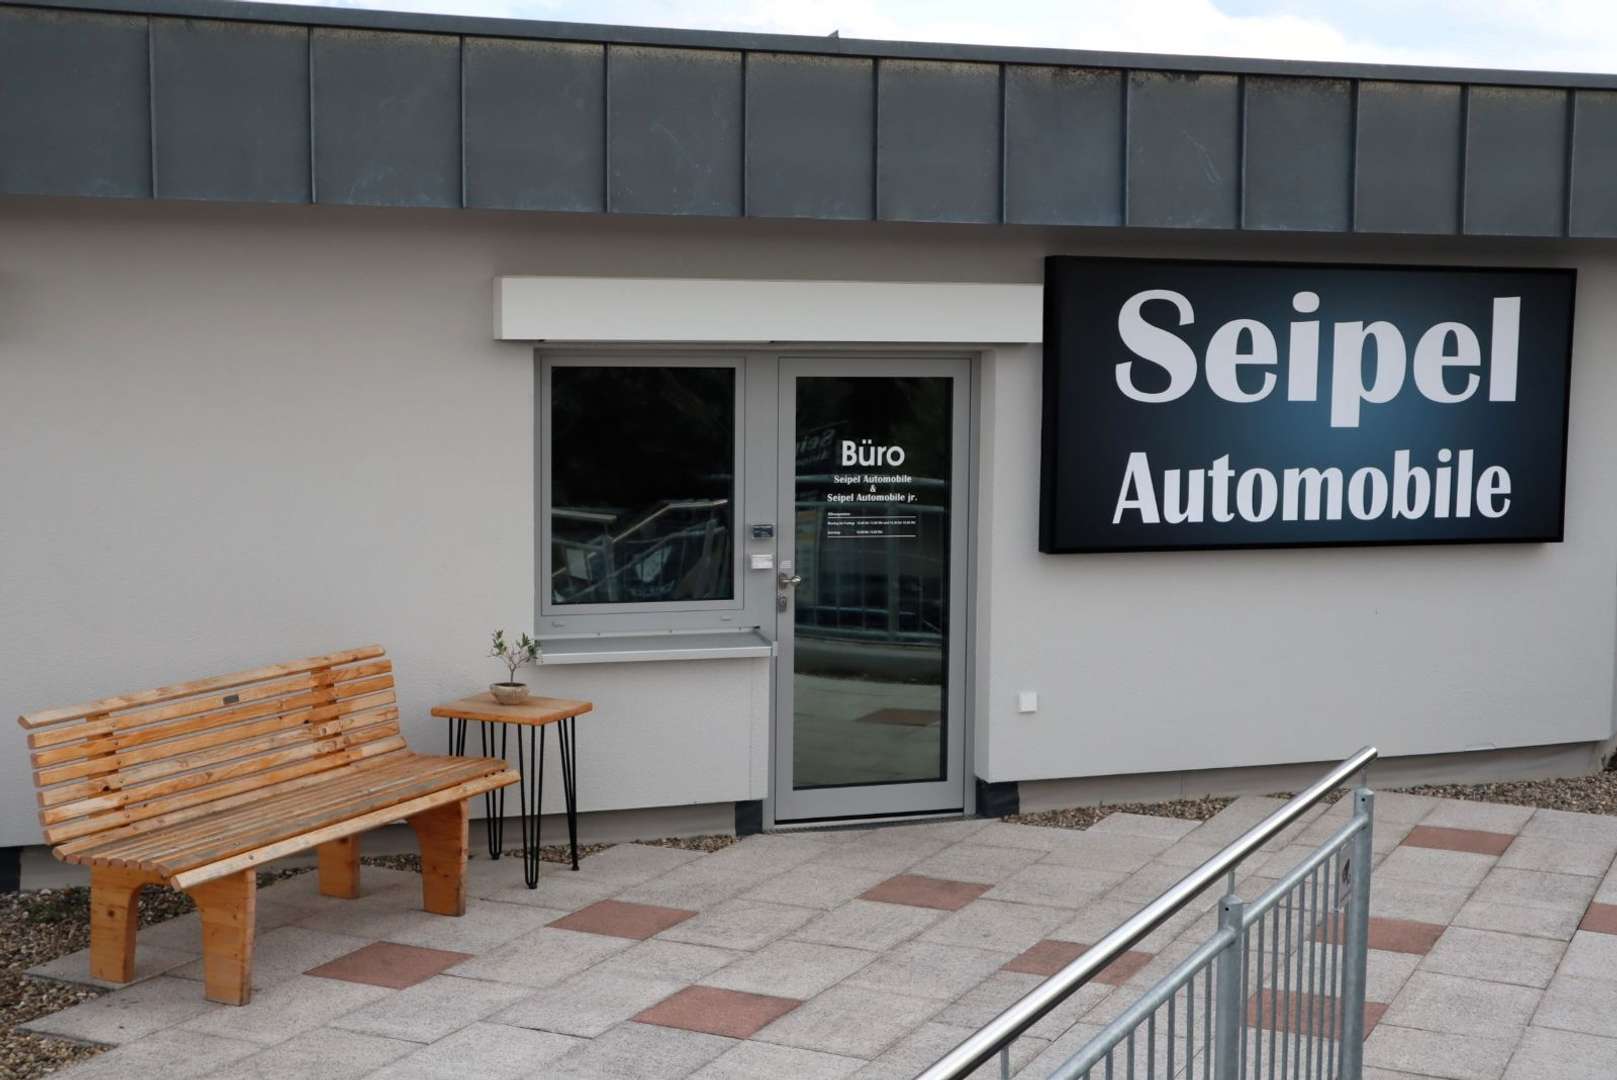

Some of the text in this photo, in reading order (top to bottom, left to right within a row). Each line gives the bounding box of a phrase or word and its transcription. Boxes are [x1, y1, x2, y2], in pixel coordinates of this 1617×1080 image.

[1115, 289, 1521, 428] Seipel
[841, 439, 905, 467] Büro
[833, 475, 912, 485] Seipel Automobile
[869, 484, 877, 492] &
[1112, 448, 1512, 524] Automobile
[826, 492, 918, 503] Seipel Automobile jr.
